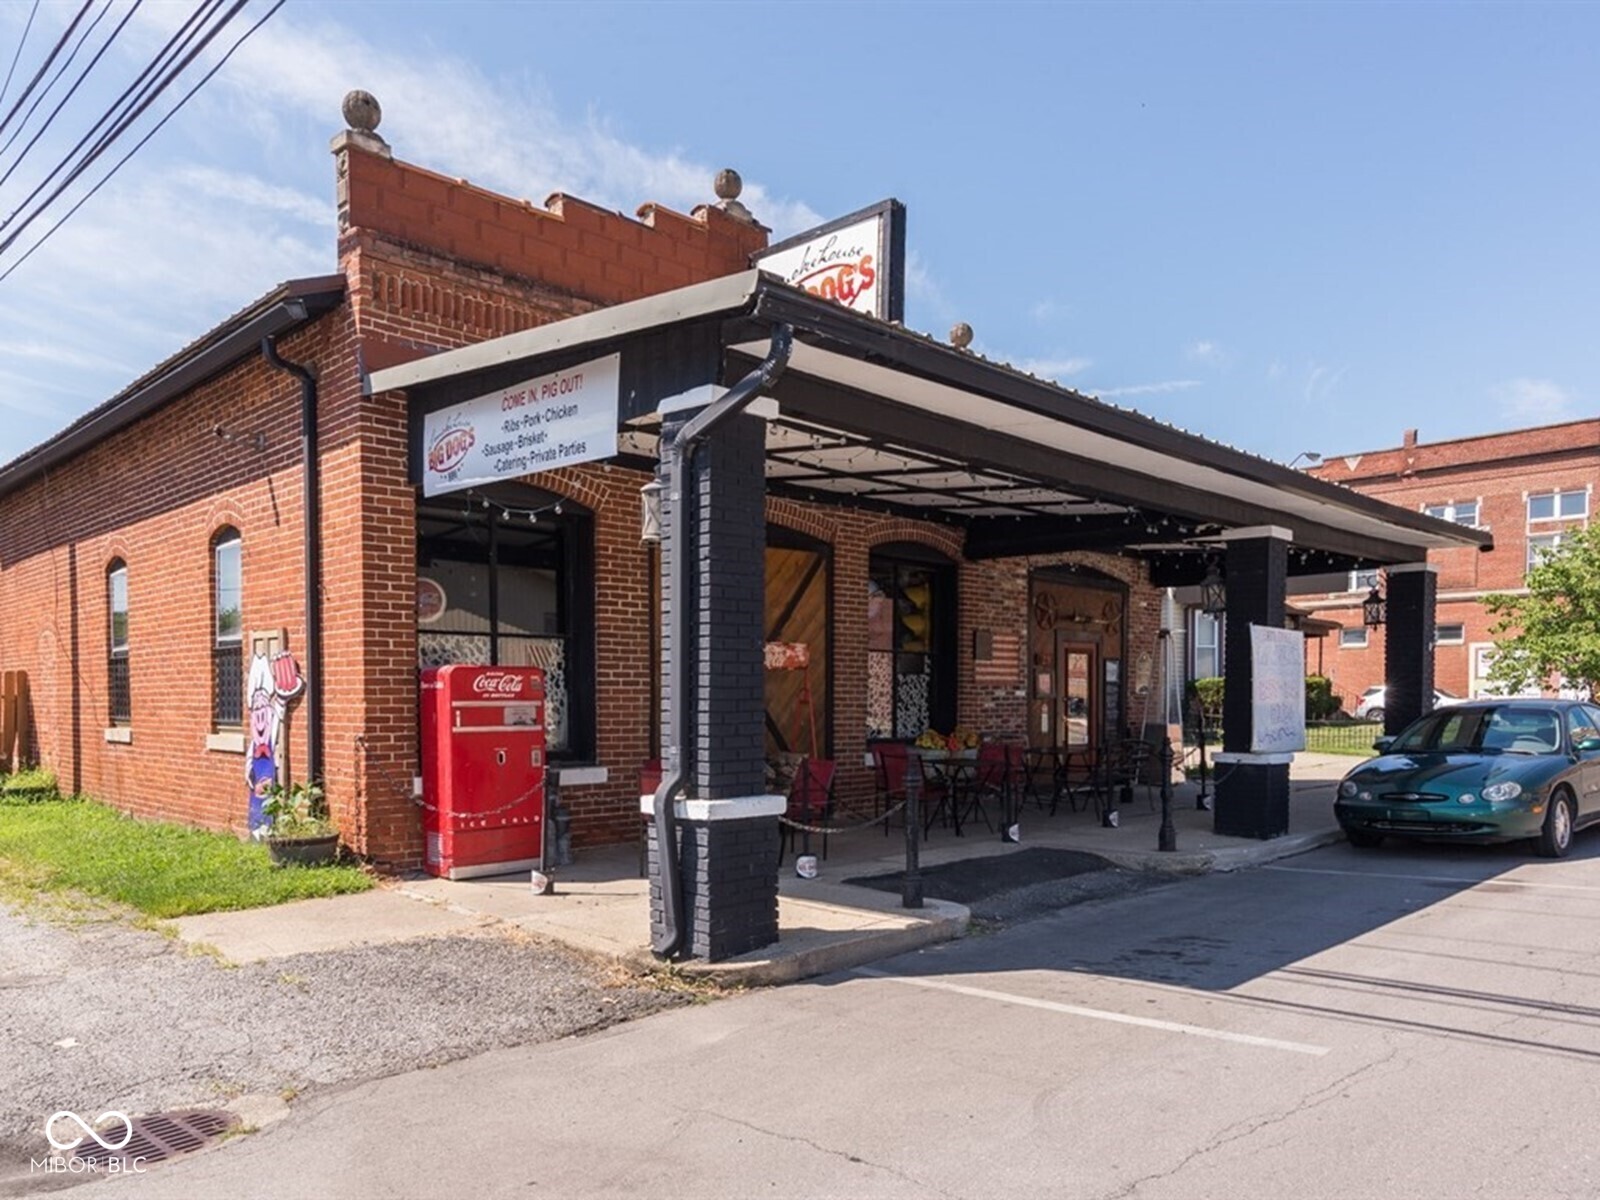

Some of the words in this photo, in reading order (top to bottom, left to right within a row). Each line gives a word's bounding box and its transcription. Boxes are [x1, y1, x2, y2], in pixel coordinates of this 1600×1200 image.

[786, 235, 864, 284] okehouse
[807, 255, 875, 301] OG'S
[502, 390, 526, 412] COME
[541, 381, 558, 400] PIG
[560, 374, 584, 395] OUT!
[558, 441, 587, 458] Parties
